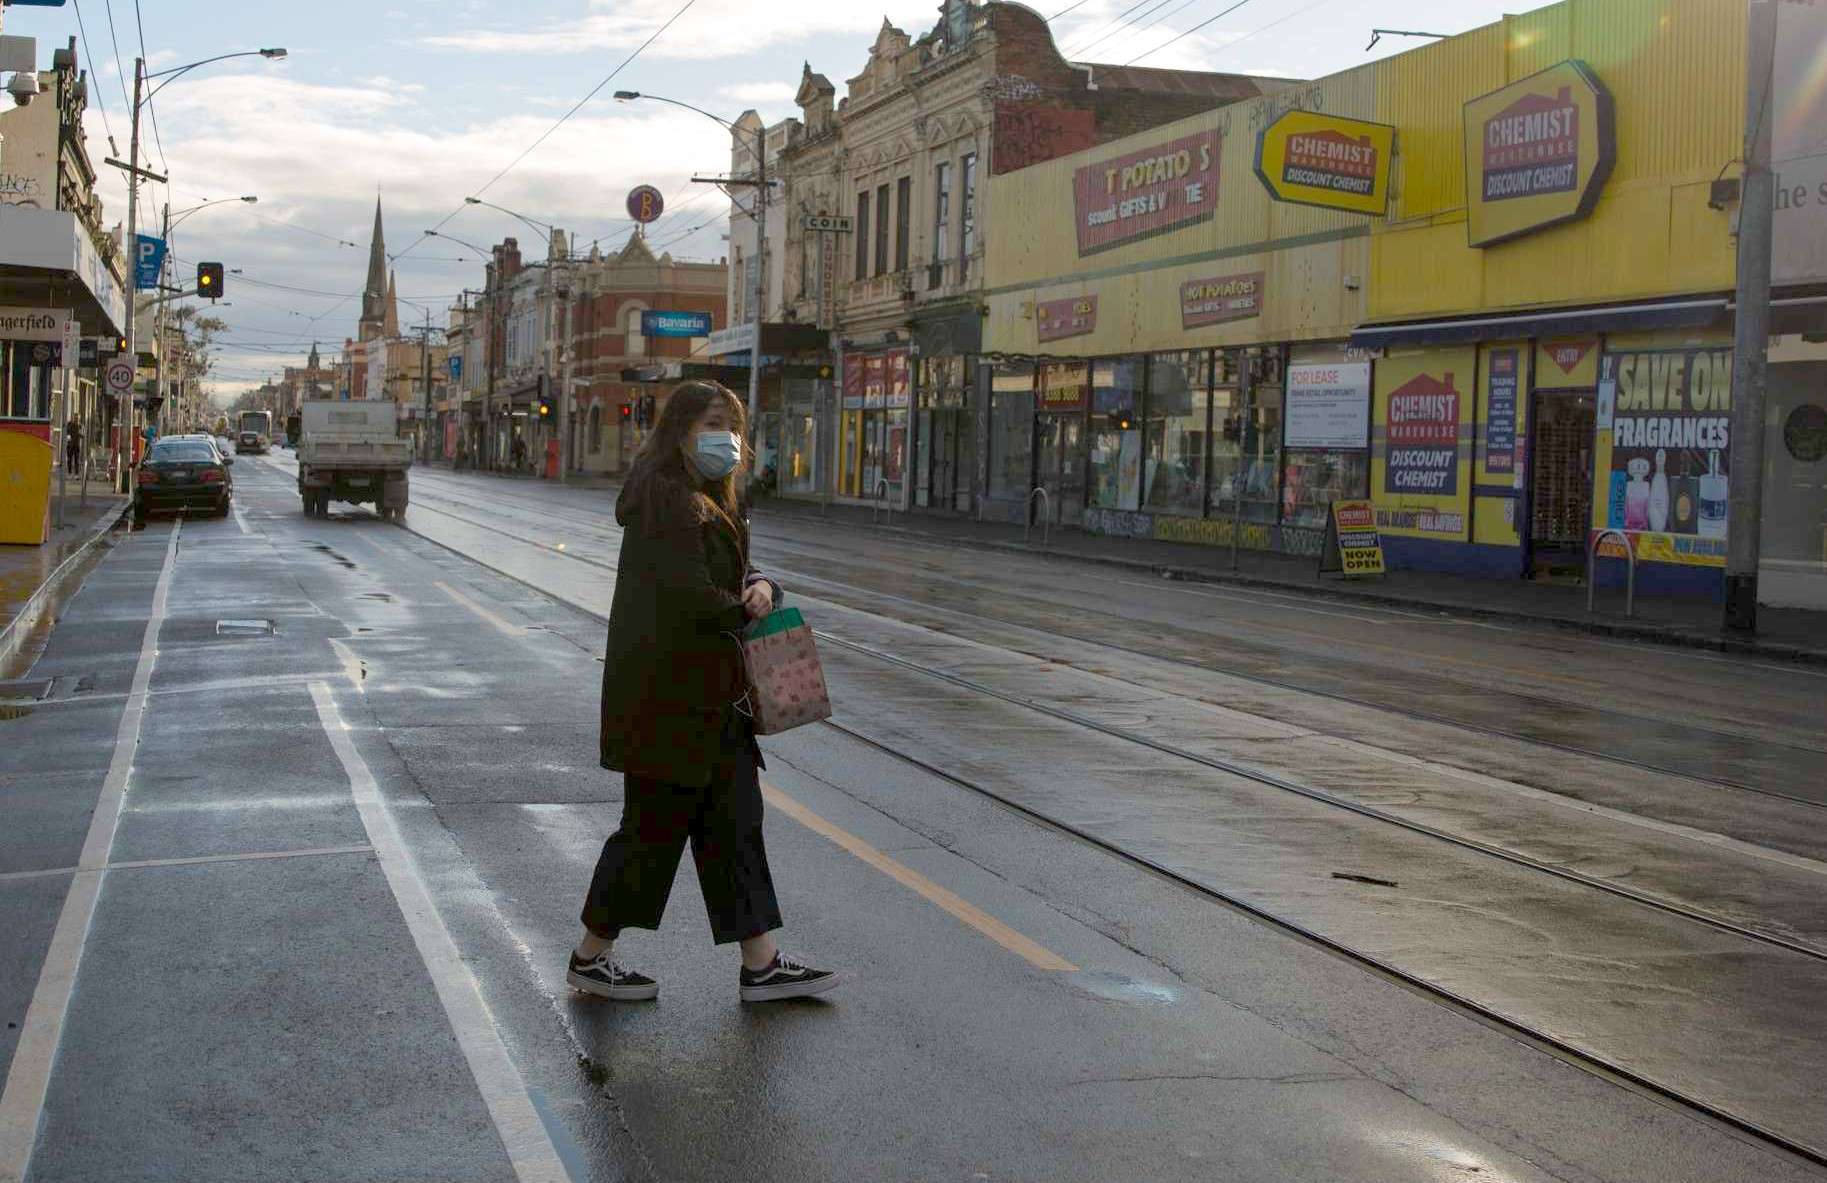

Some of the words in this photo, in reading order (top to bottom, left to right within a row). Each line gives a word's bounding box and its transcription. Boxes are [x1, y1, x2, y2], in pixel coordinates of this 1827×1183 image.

[1489, 107, 1574, 149] CHEMIST
[1291, 136, 1373, 164] CHEMIST
[1121, 148, 1192, 192] POTATO
[1287, 168, 1332, 188] DISCOUNT
[1333, 175, 1371, 192] CHEMIST
[1487, 169, 1532, 196] DISCOUNT
[1533, 163, 1574, 188] CHEMIST
[1775, 172, 1807, 209] he
[809, 218, 849, 229] COIN
[140, 243, 155, 262] P
[658, 317, 705, 329] Bavaria
[111, 371, 129, 383] 40
[1291, 370, 1308, 386] FOR
[1311, 369, 1339, 385] LEASE
[1618, 353, 1684, 411] SAVE
[1691, 352, 1732, 411] ON
[1391, 394, 1456, 422] CHEMIST
[1613, 417, 1729, 449] FRAGRANCES
[1390, 450, 1454, 467] DISCOUNT
[1394, 470, 1449, 488] CHEMIST
[1344, 550, 1377, 559] NOW
[1346, 560, 1381, 569] OPEN
